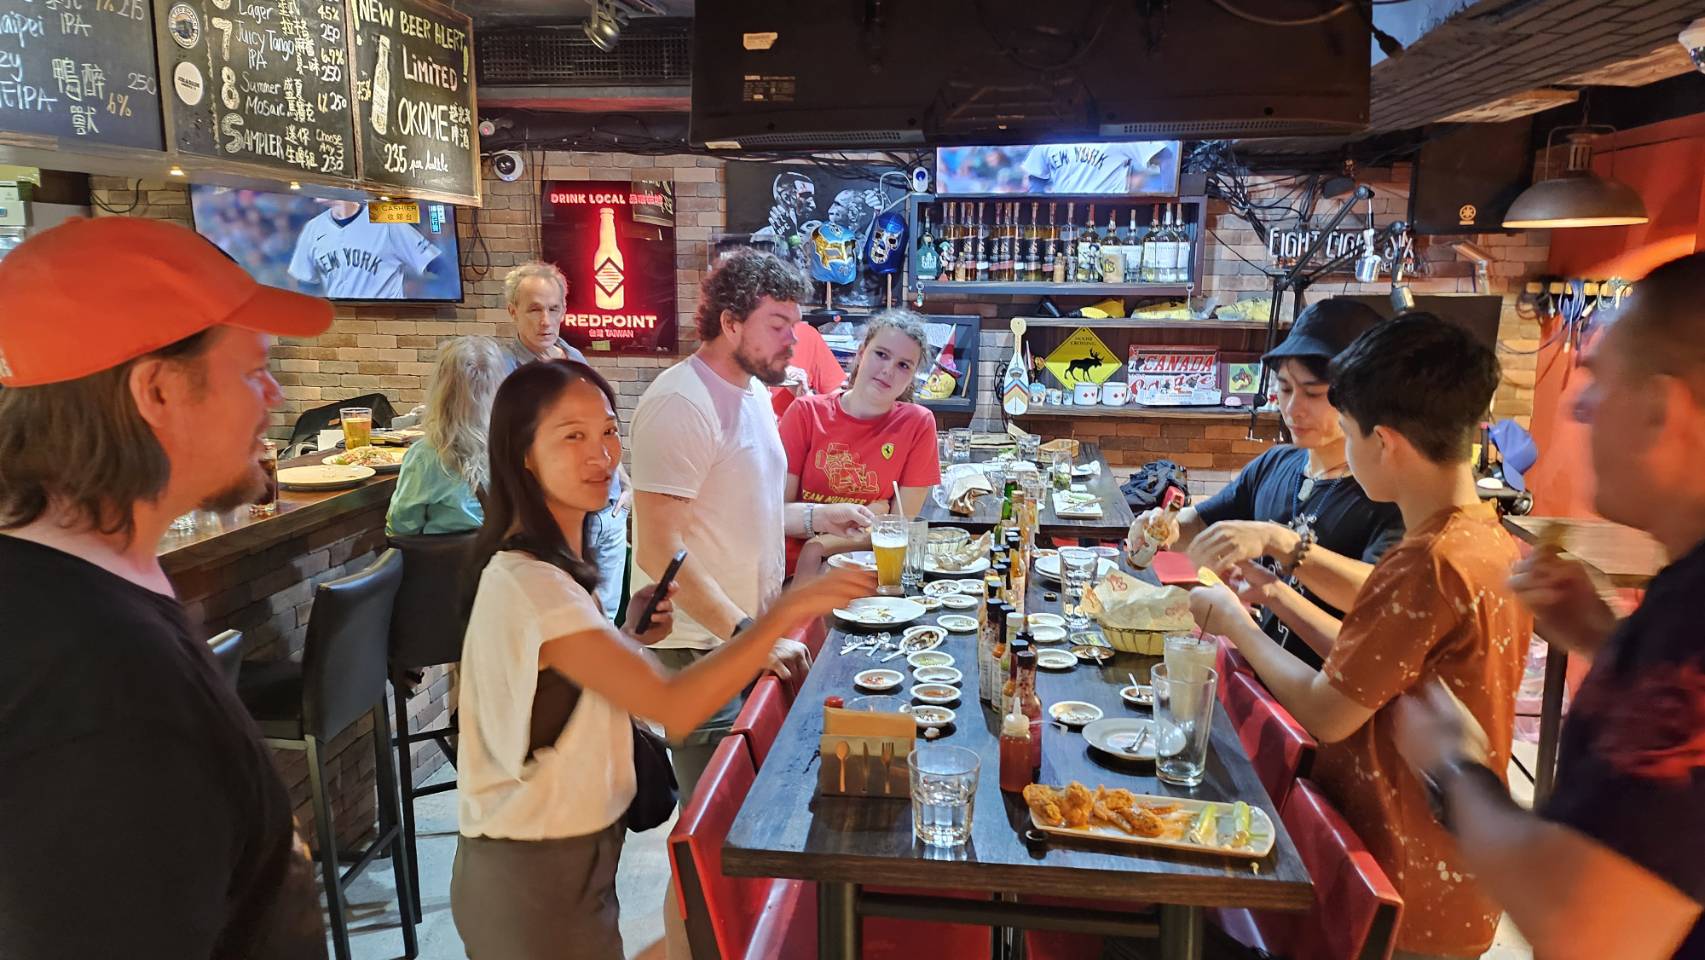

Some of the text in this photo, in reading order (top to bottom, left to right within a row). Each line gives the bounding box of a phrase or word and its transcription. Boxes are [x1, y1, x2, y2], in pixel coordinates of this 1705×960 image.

[60, 12, 93, 37] IPA
[239, 0, 273, 24] Lager
[359, 0, 394, 28] NEW
[400, 10, 431, 40] BEER
[211, 17, 233, 61] 7
[233, 19, 266, 53] Juicy
[265, 29, 295, 61] Tango
[247, 47, 268, 70] IPA
[128, 72, 157, 96] 250
[240, 71, 281, 95] Summer
[320, 65, 341, 82] 250
[0, 81, 58, 113] EIPA
[221, 66, 240, 110] 8
[107, 92, 132, 117] 6%
[398, 97, 449, 142] OKOME
[221, 113, 284, 160] SAMPLER
[320, 155, 344, 173] 230
[384, 143, 407, 174] 235
[551, 193, 586, 204] DRINK
[589, 193, 625, 205] LOCAL
[343, 247, 382, 276] YORK
[564, 313, 658, 329] REDPOINT
[1144, 354, 1215, 372] CANADA
